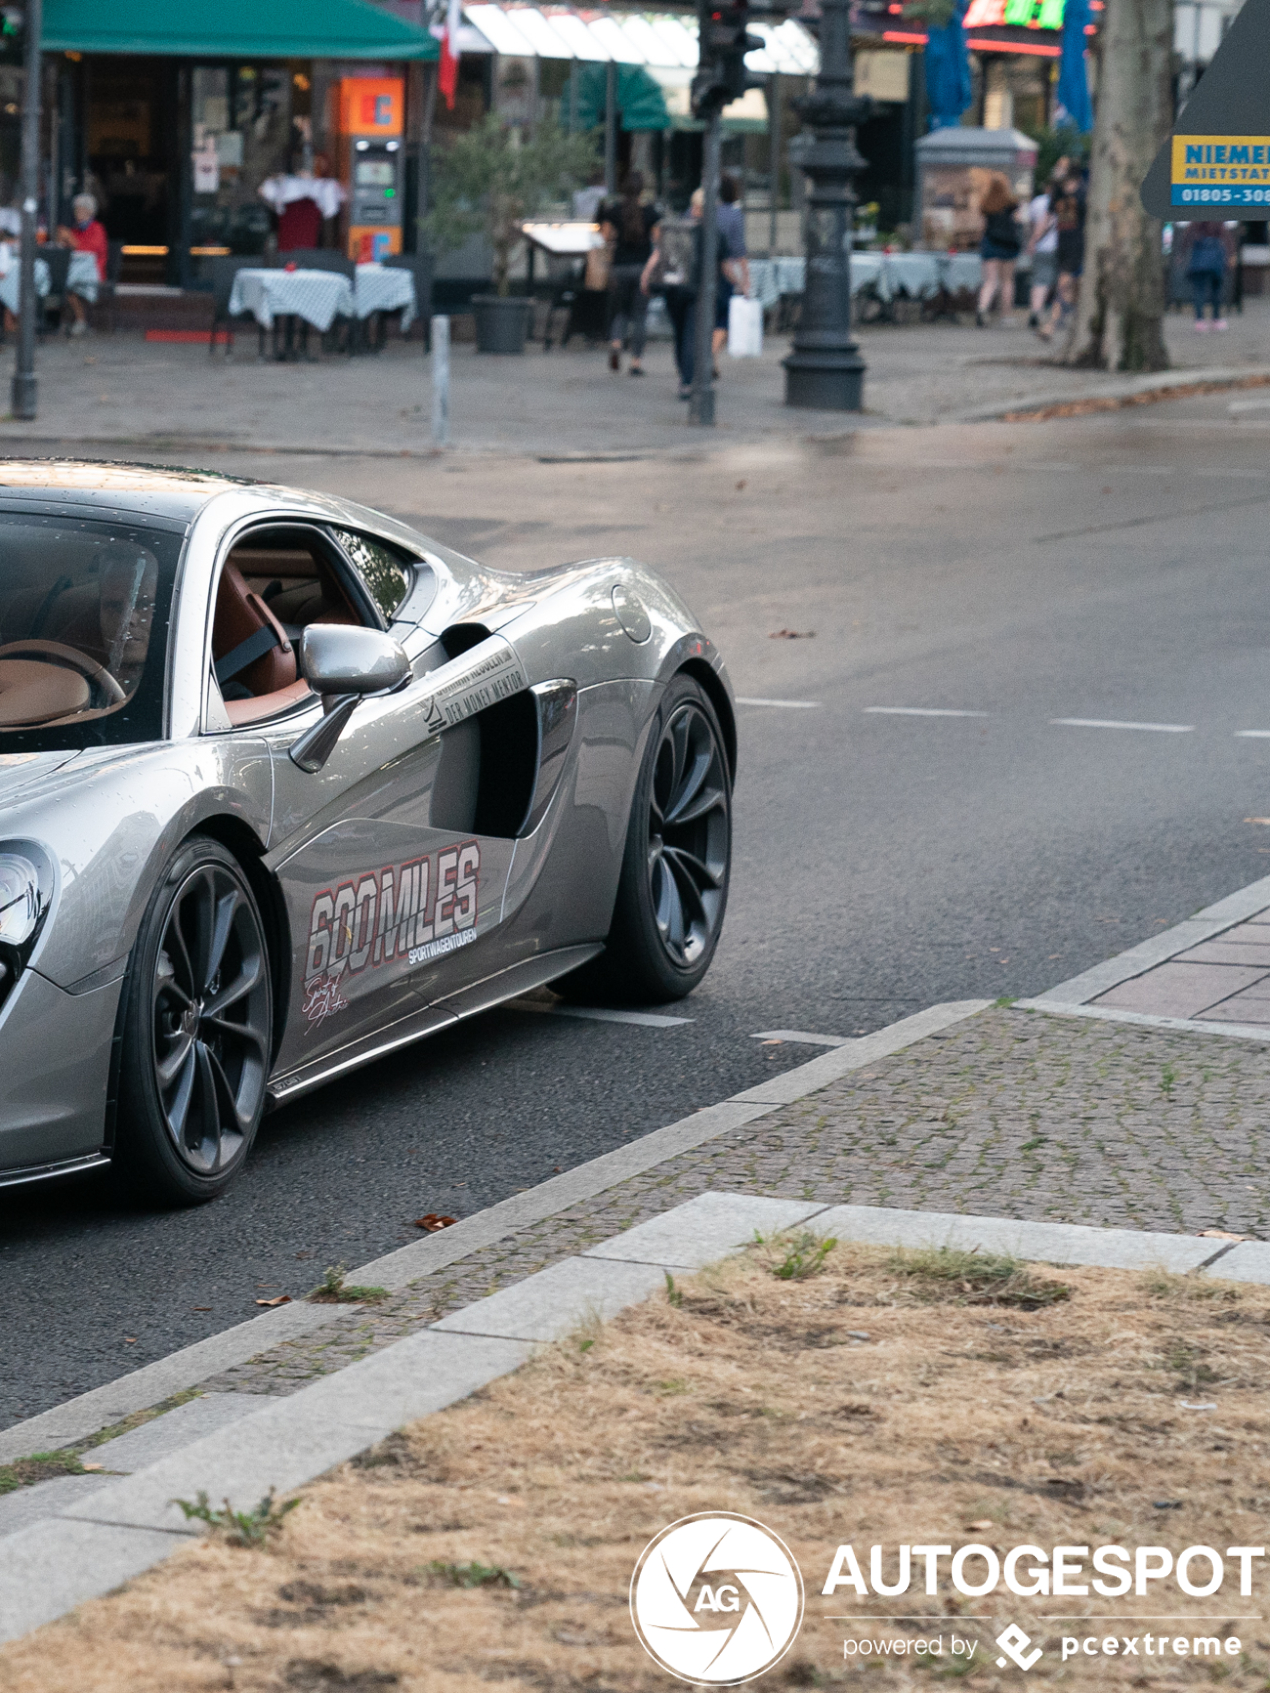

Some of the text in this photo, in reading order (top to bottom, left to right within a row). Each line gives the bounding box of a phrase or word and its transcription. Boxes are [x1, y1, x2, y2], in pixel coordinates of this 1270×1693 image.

[1185, 145, 1270, 165] NIEME
[445, 702, 464, 725] DER
[463, 687, 491, 714] MONEY
[491, 670, 524, 700] MENTOR
